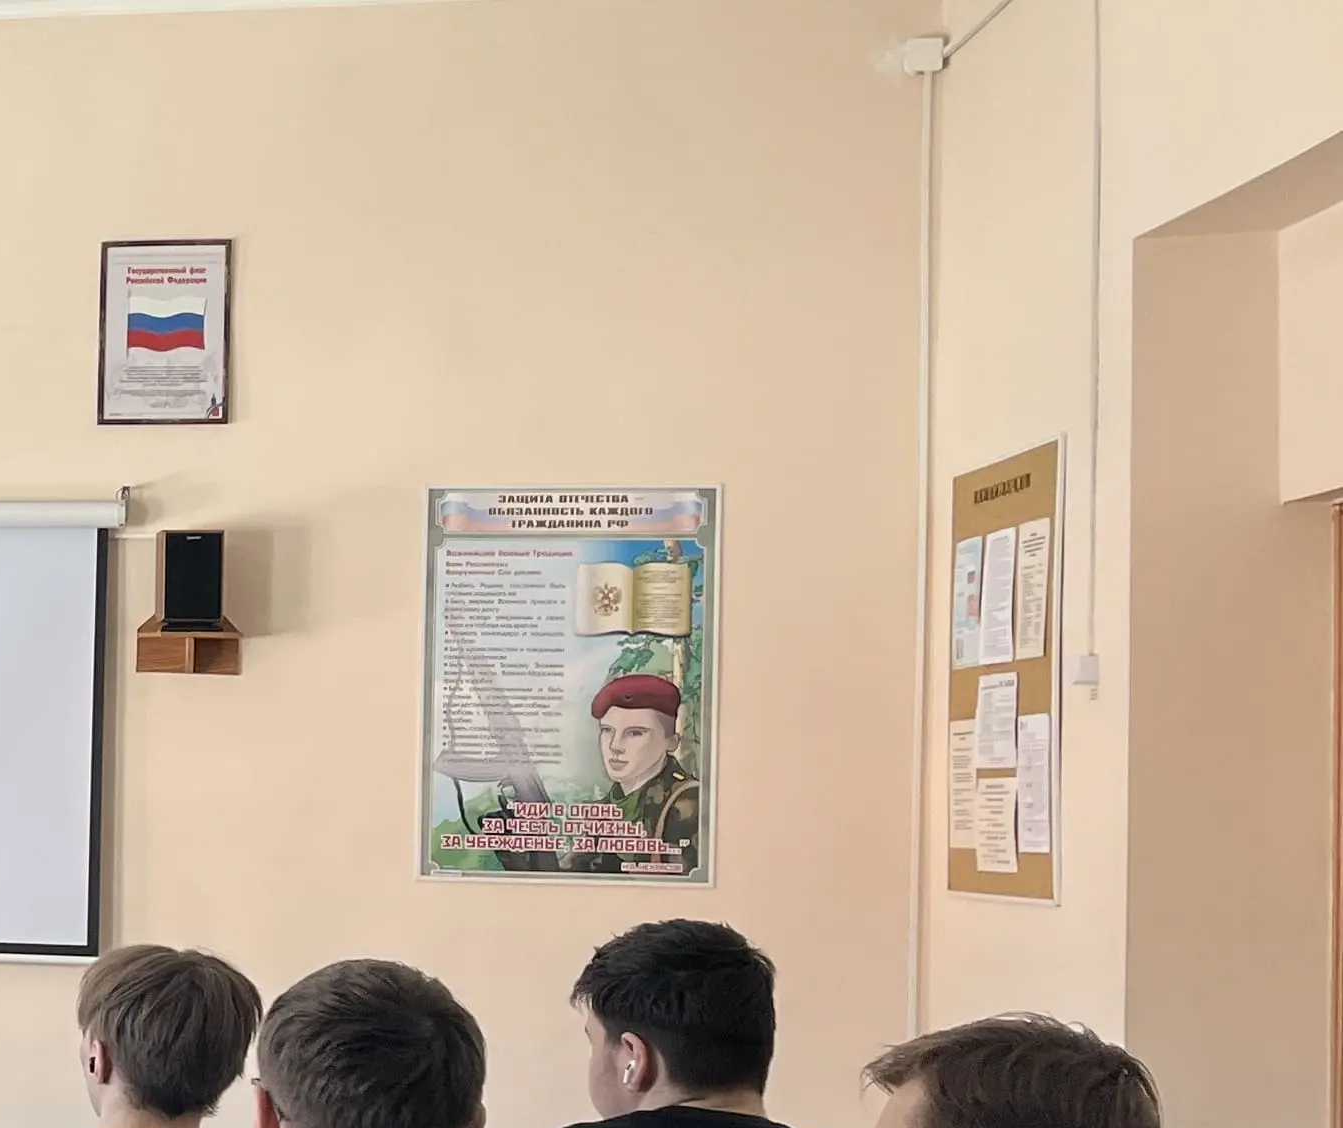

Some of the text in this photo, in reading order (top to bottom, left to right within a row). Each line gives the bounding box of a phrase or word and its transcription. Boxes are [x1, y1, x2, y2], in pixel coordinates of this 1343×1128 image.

[498, 494, 629, 504] ЗАЩИТА ОТЕЧЕСТВА
[488, 507, 653, 517] ОБЯЗАННОСТЬ КАЖДОГО
[512, 519, 629, 529] ГРАЖДАНИНА РФ
[555, 805, 565, 817] В
[570, 804, 622, 819] ОГОНЬ
[483, 820, 647, 836] ЗА ЧЕСТЬ ОТЧИЗНЫ,
[442, 836, 461, 848] ЗА
[573, 838, 593, 850] ЗА
